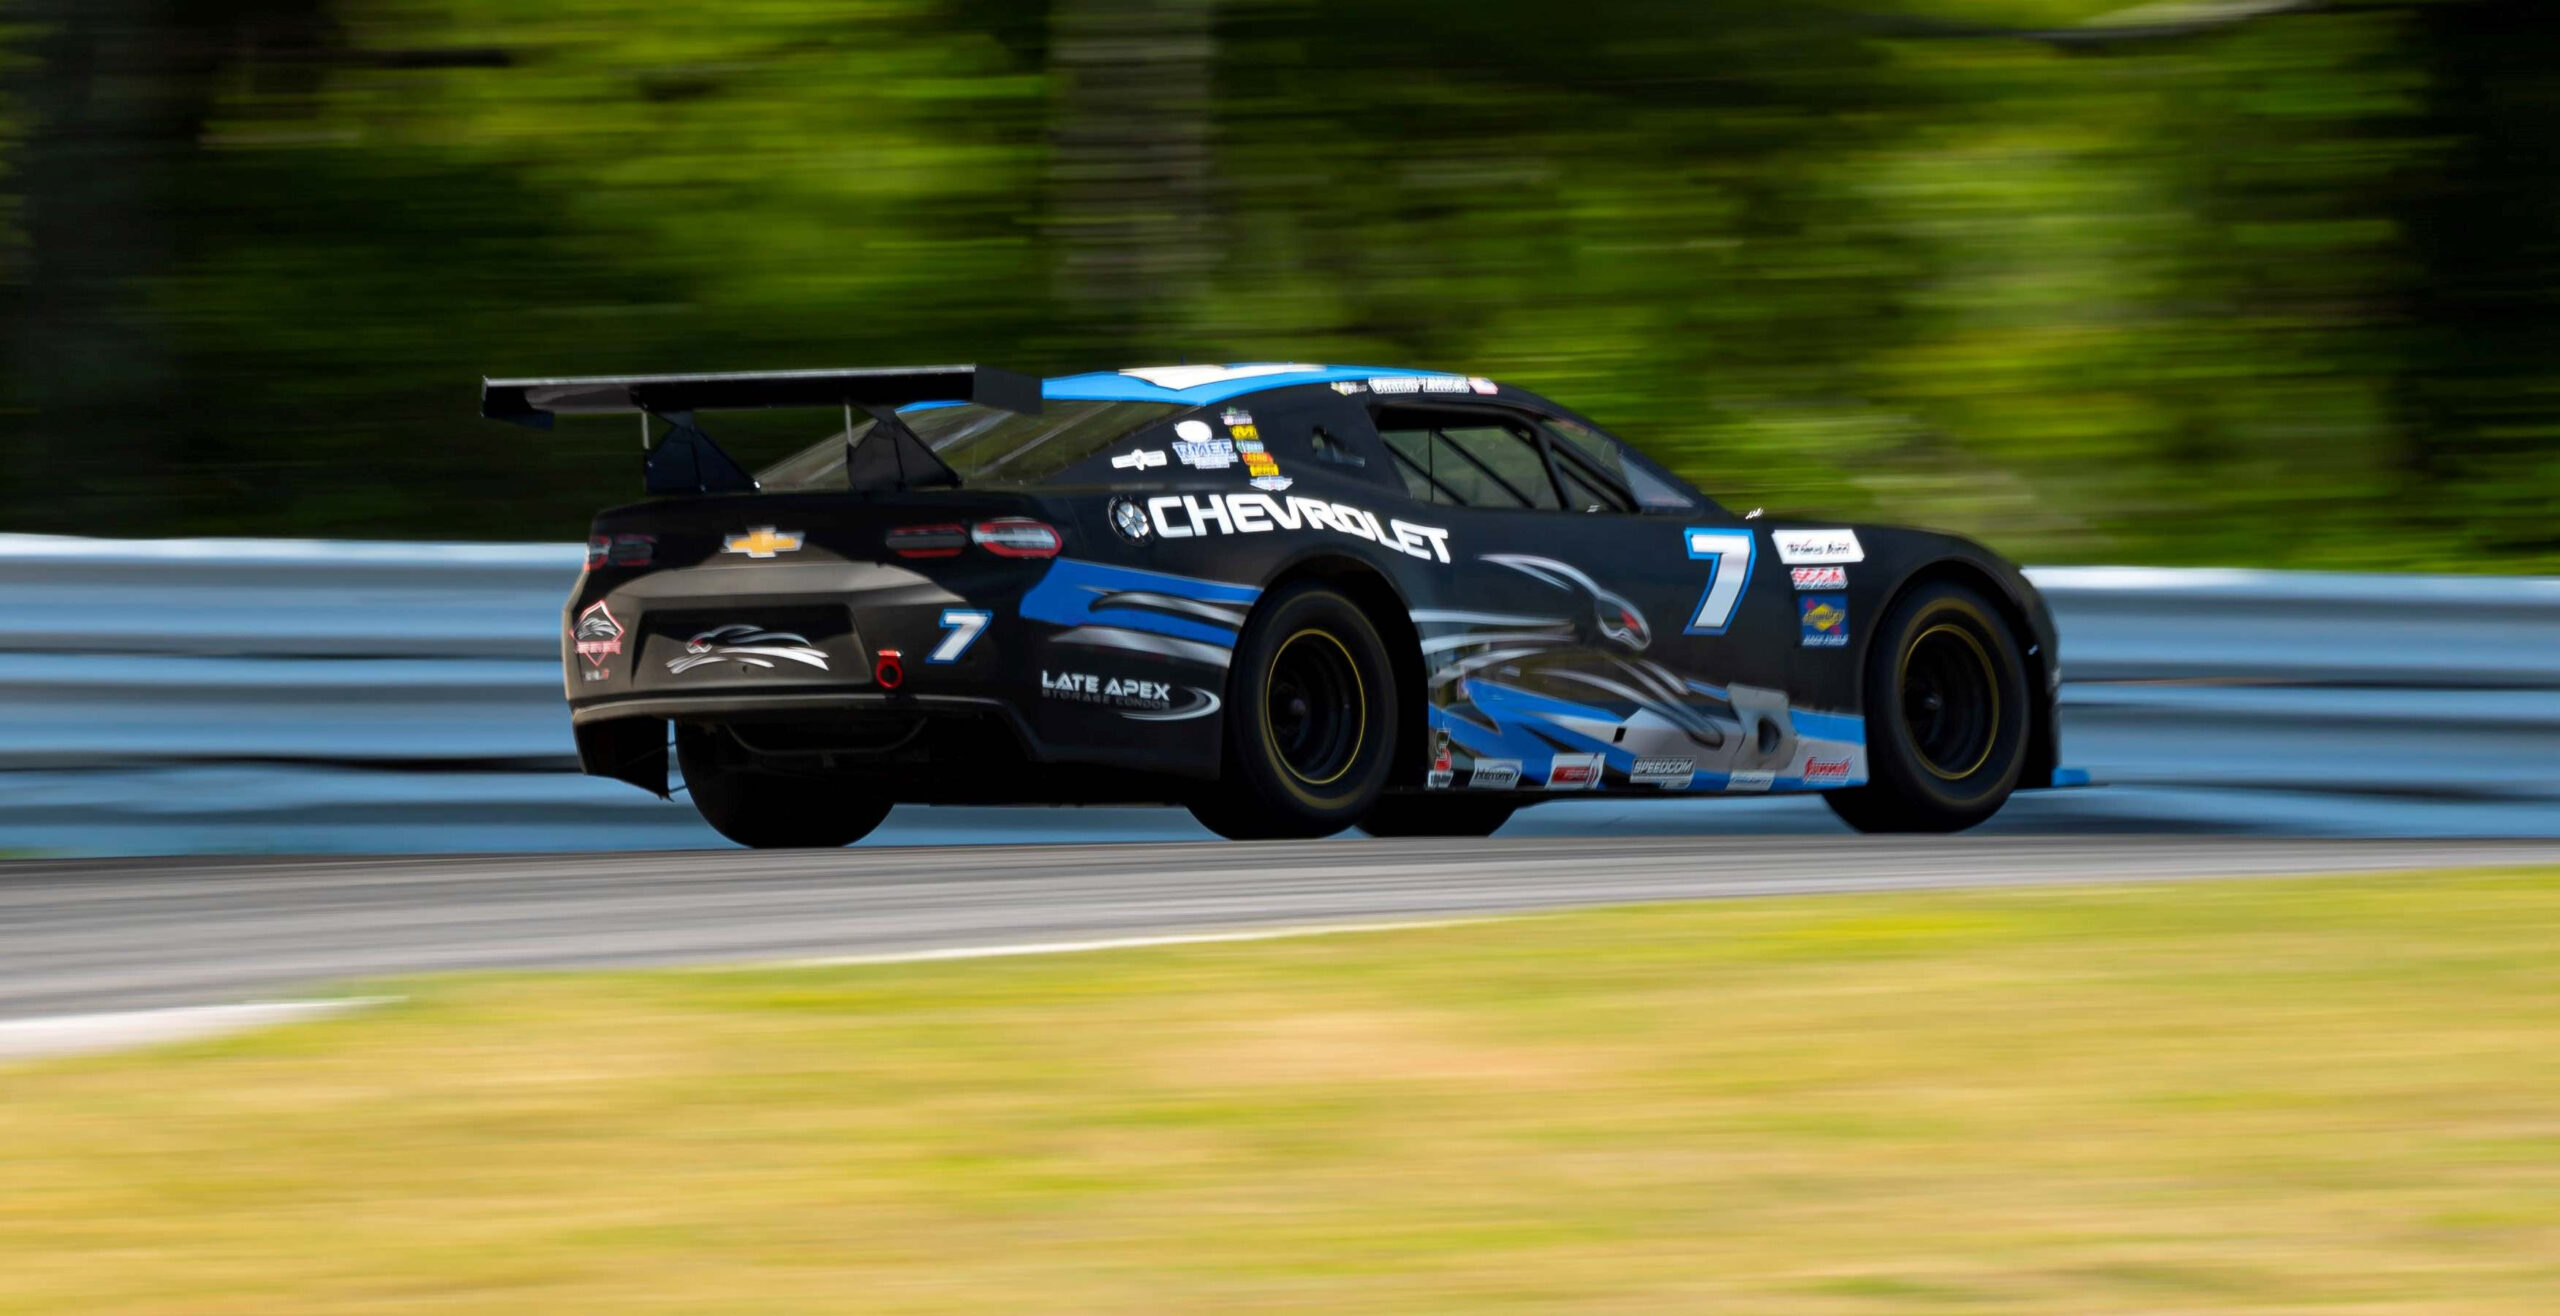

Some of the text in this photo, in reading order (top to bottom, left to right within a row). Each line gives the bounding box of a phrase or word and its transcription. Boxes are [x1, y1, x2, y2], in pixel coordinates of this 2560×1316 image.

[1148, 494, 1451, 564] CHEVROLET
[1683, 527, 1757, 635] 7
[925, 608, 993, 664] 7
[1042, 670, 1170, 701] LATE APEX
[1633, 758, 1694, 776] SPEEDCOM
